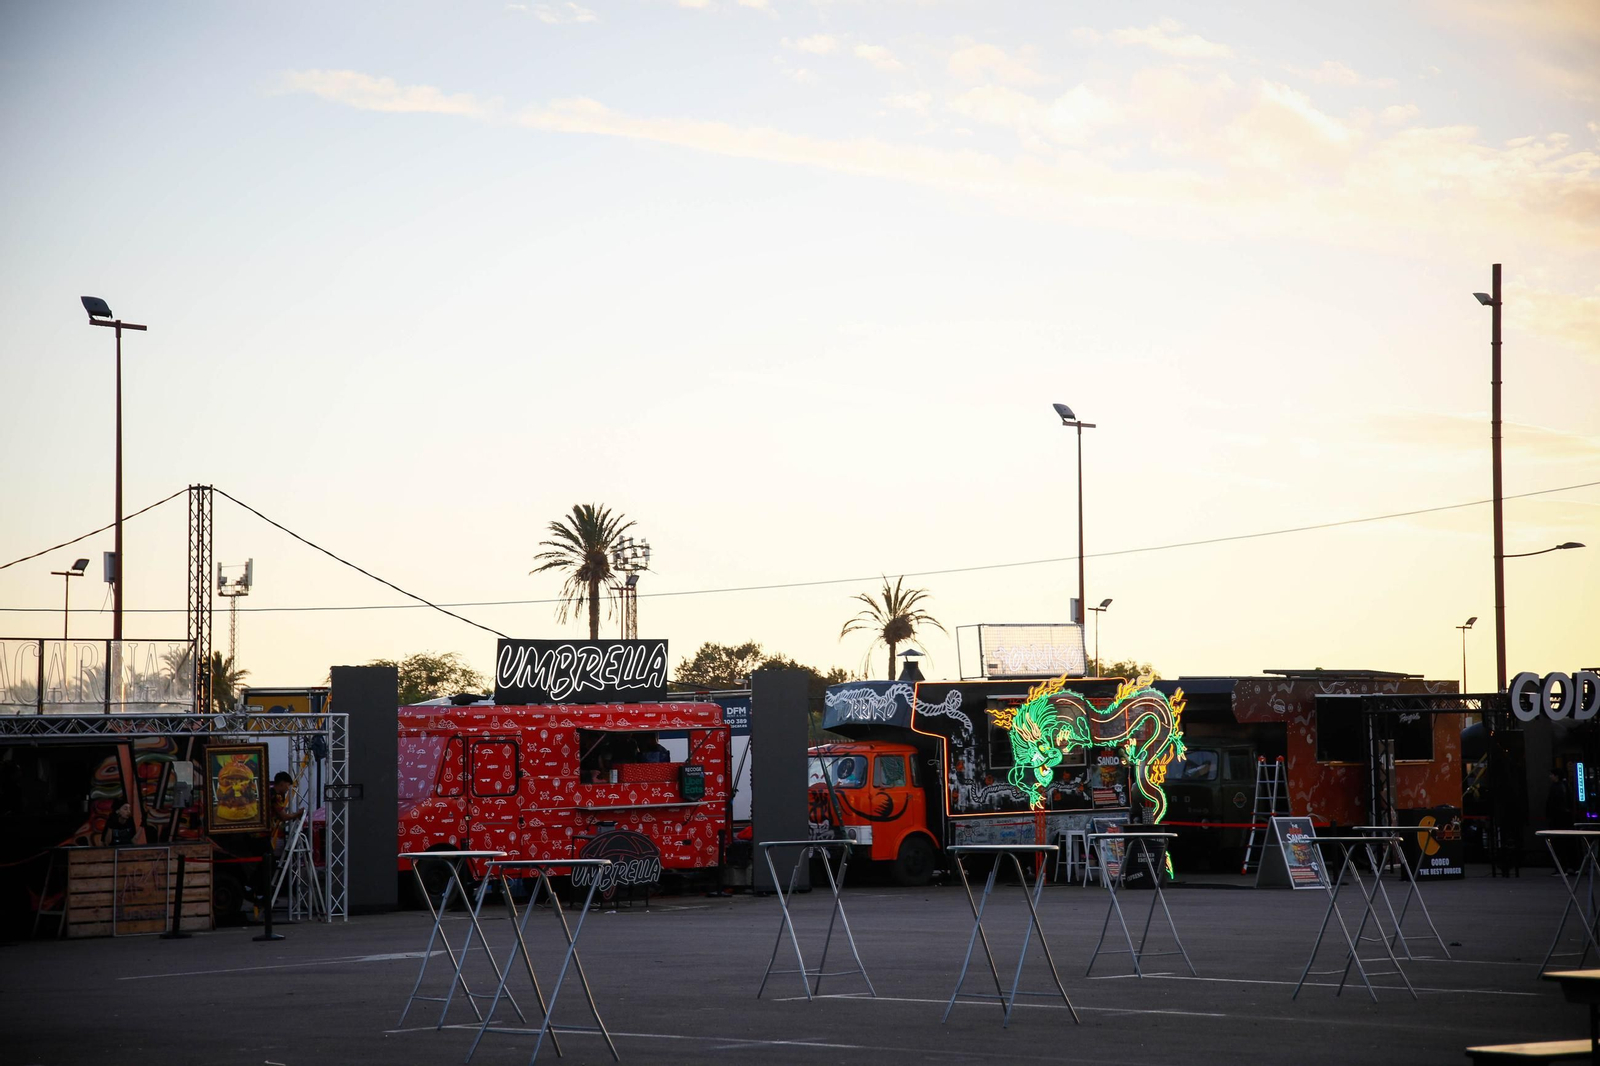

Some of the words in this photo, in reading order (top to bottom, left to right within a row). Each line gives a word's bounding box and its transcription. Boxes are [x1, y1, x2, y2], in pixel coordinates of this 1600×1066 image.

[497, 645, 667, 701] UMBRELLA
[1510, 672, 1600, 722] GOD
[726, 706, 747, 715] DFM
[1097, 756, 1120, 766] SANDO
[684, 777, 703, 785] Uber
[685, 786, 703, 794] Eats
